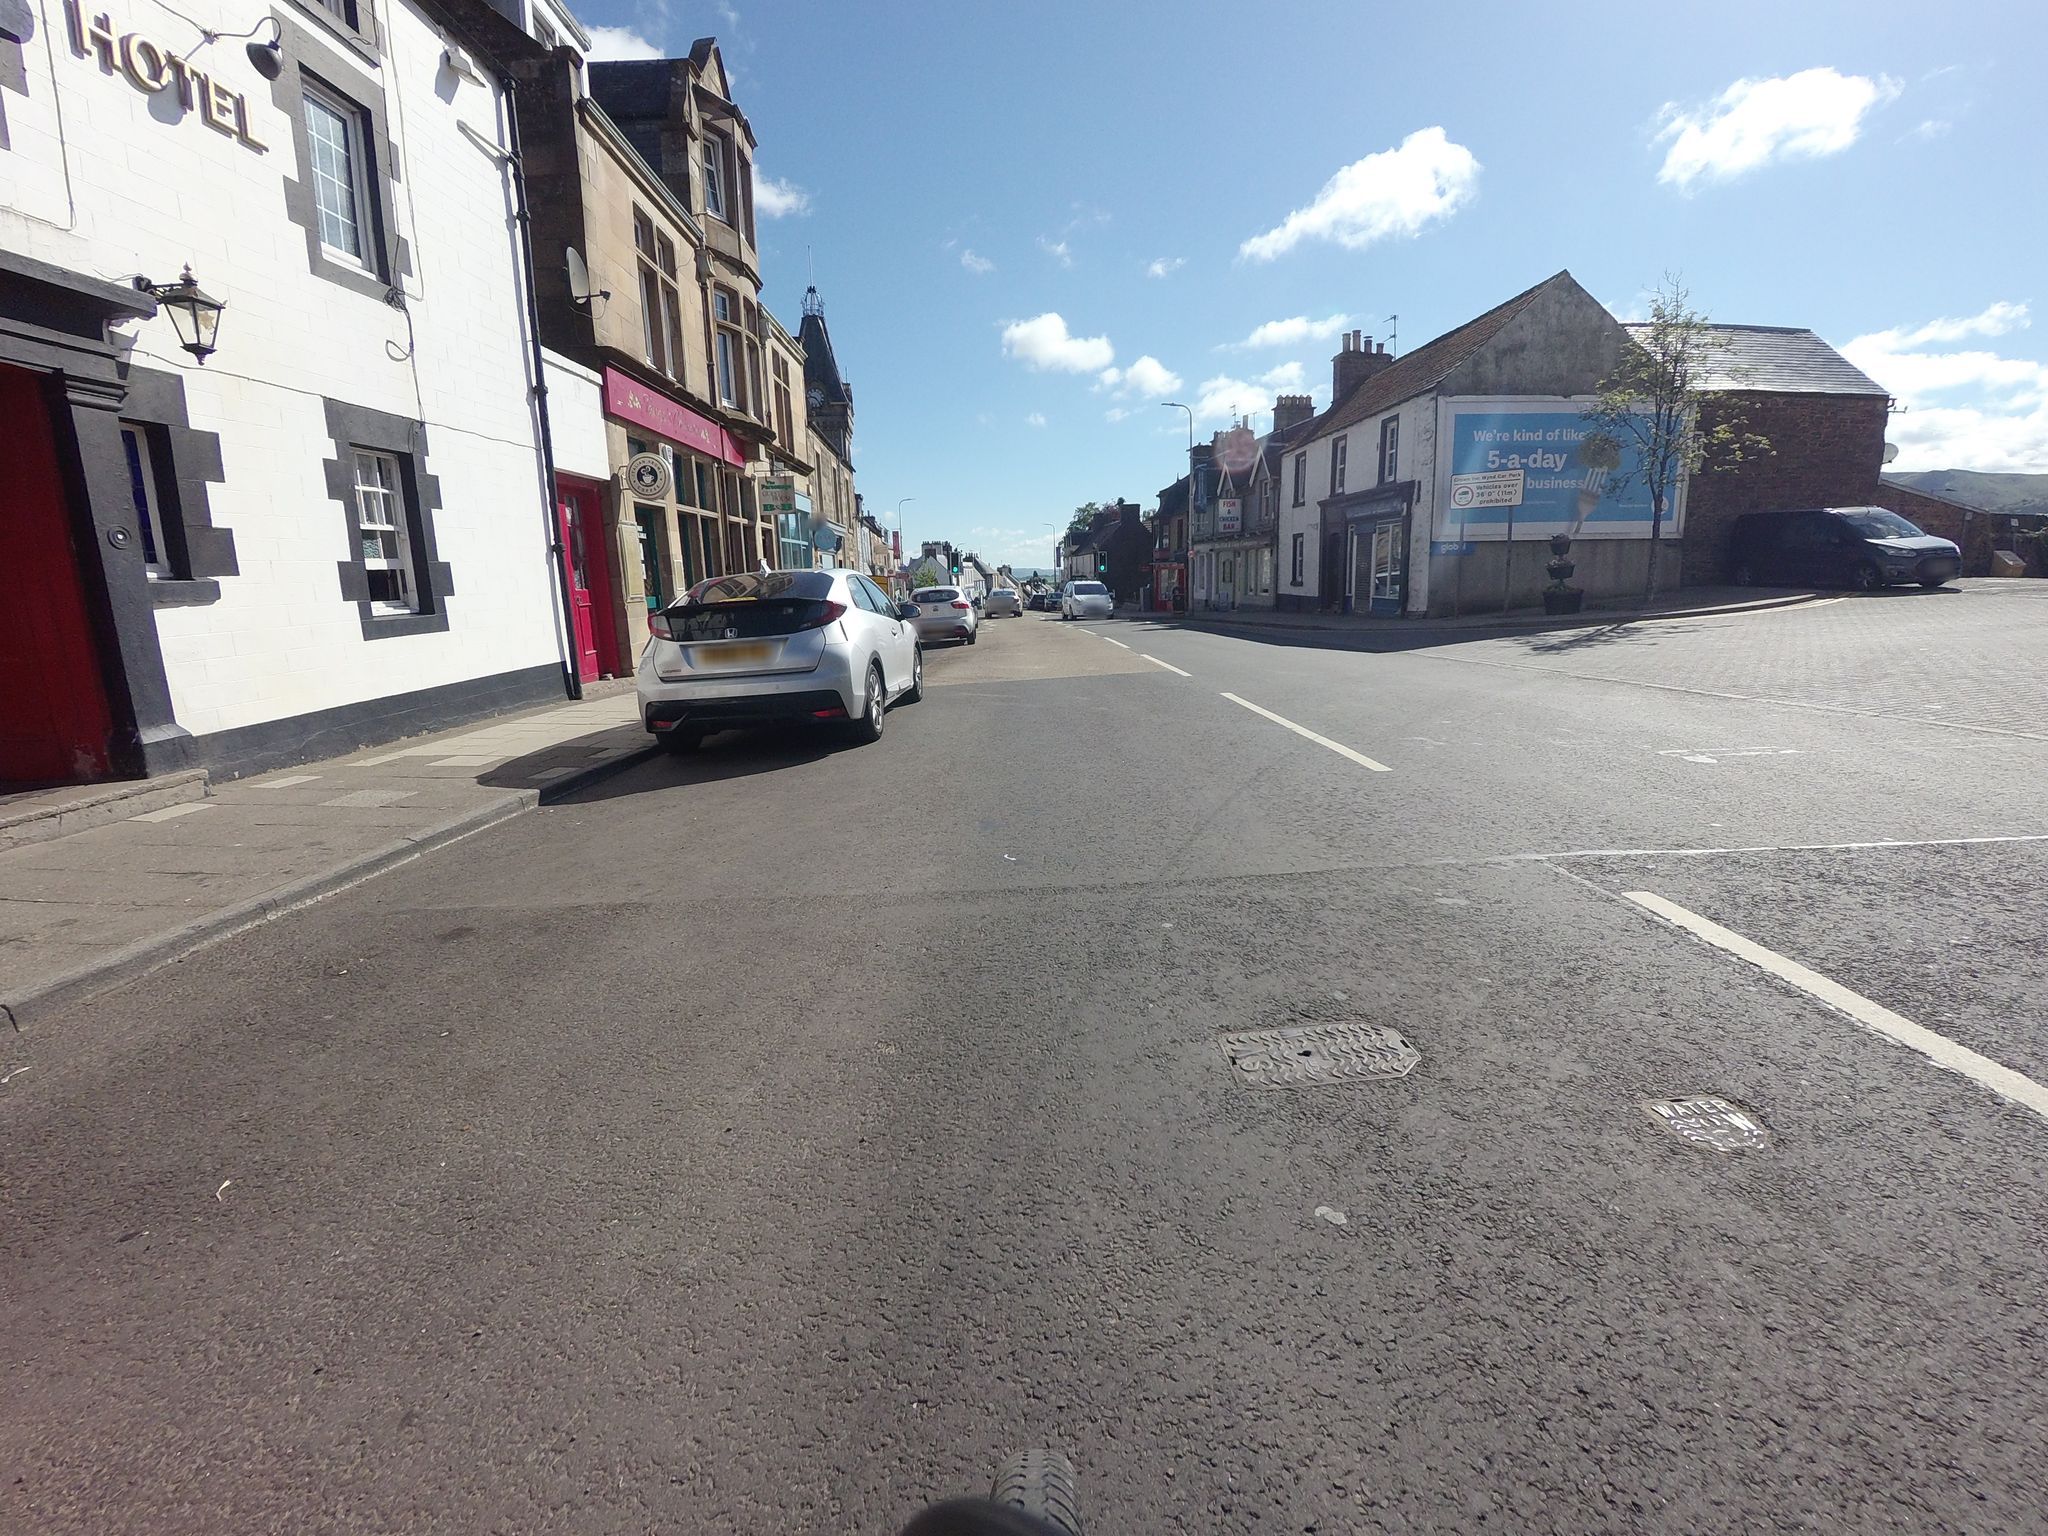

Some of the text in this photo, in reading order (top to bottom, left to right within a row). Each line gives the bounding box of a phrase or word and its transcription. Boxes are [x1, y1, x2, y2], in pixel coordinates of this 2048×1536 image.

[64, 0, 269, 153] HOTEL
[1474, 428, 1586, 441] We're kind of like
[1487, 448, 1568, 472] 5-a-day
[1527, 476, 1585, 489] business
[1479, 497, 1512, 505] prohibited
[1440, 542, 1466, 554] globl
[1651, 1100, 1734, 1118] WATER
